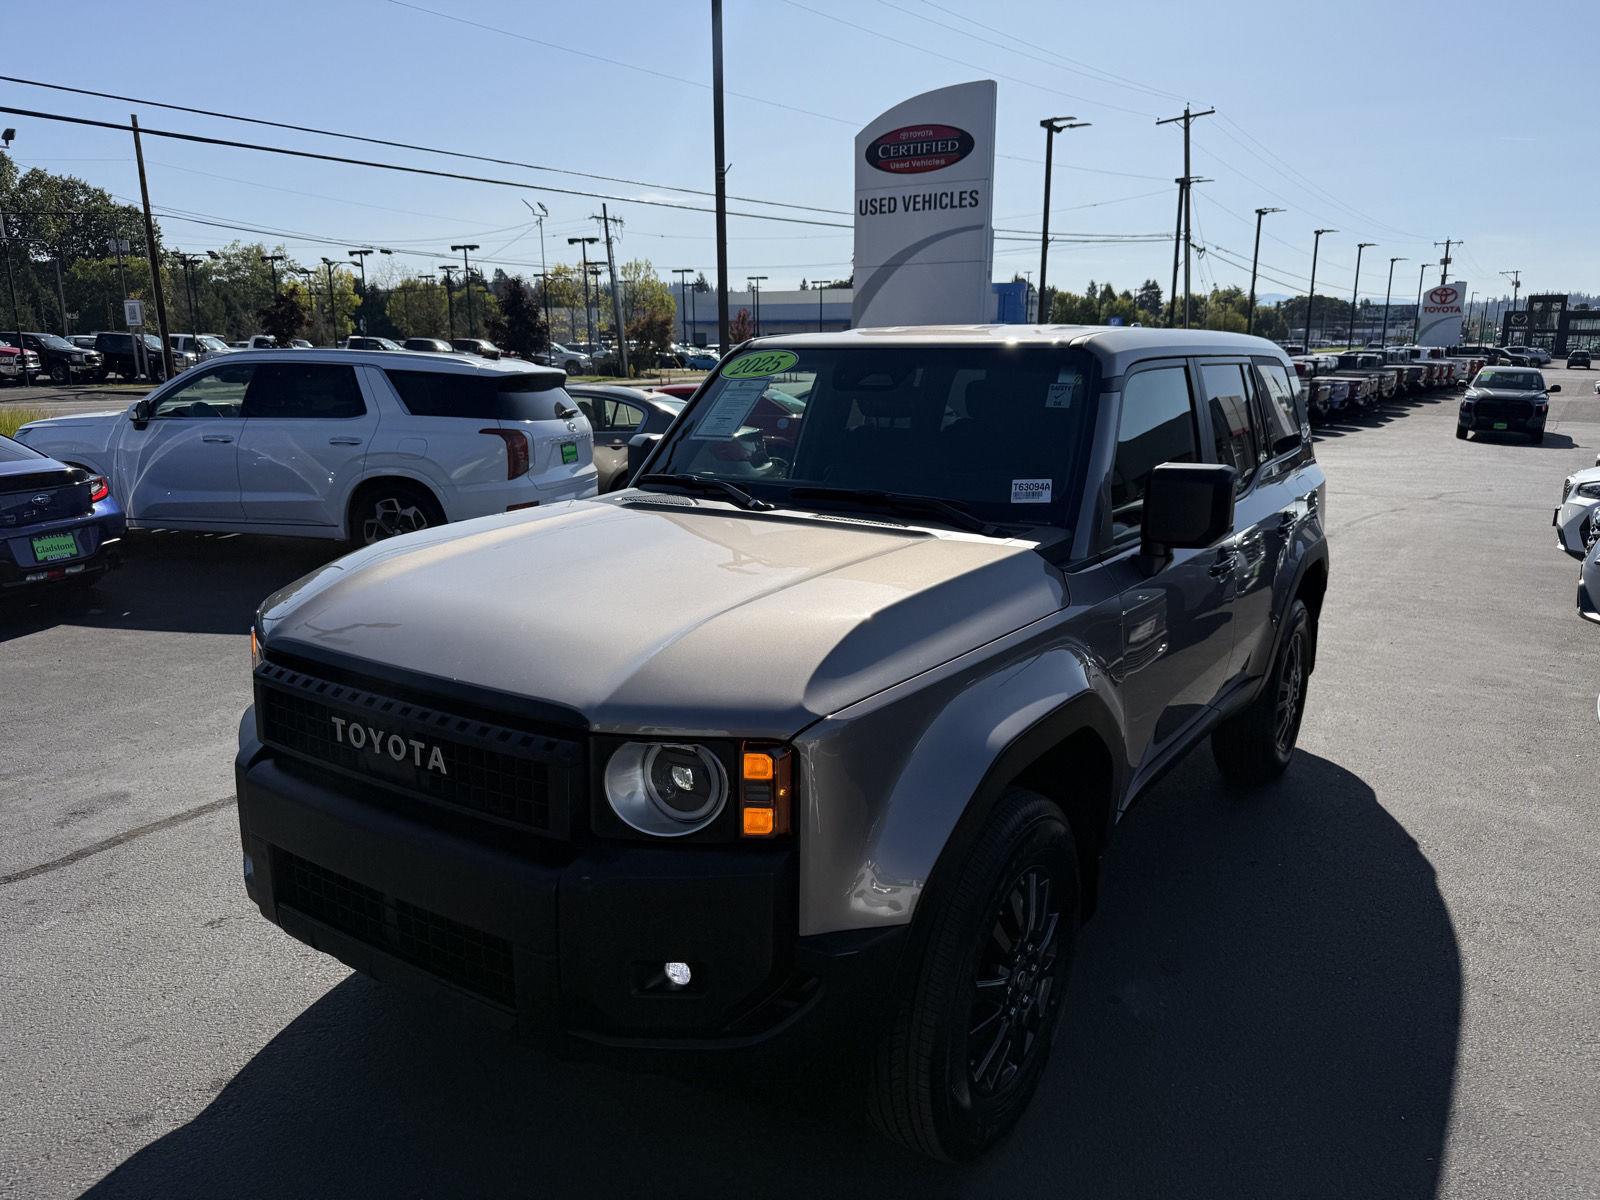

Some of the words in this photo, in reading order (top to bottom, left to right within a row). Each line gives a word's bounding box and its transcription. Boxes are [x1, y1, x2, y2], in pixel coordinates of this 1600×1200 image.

[910, 130, 933, 138] TOYOTA
[878, 140, 959, 158] CERTIFIED
[890, 161, 909, 169] Used
[911, 158, 945, 168] Vehicles
[859, 196, 897, 216] USED
[902, 190, 979, 212] VEHICLES
[1424, 305, 1461, 313] TOYOTA
[729, 355, 787, 376] 2025
[1014, 483, 1050, 491] T63094A
[36, 543, 75, 554] Gladstone
[331, 716, 447, 775] TOYOTA
